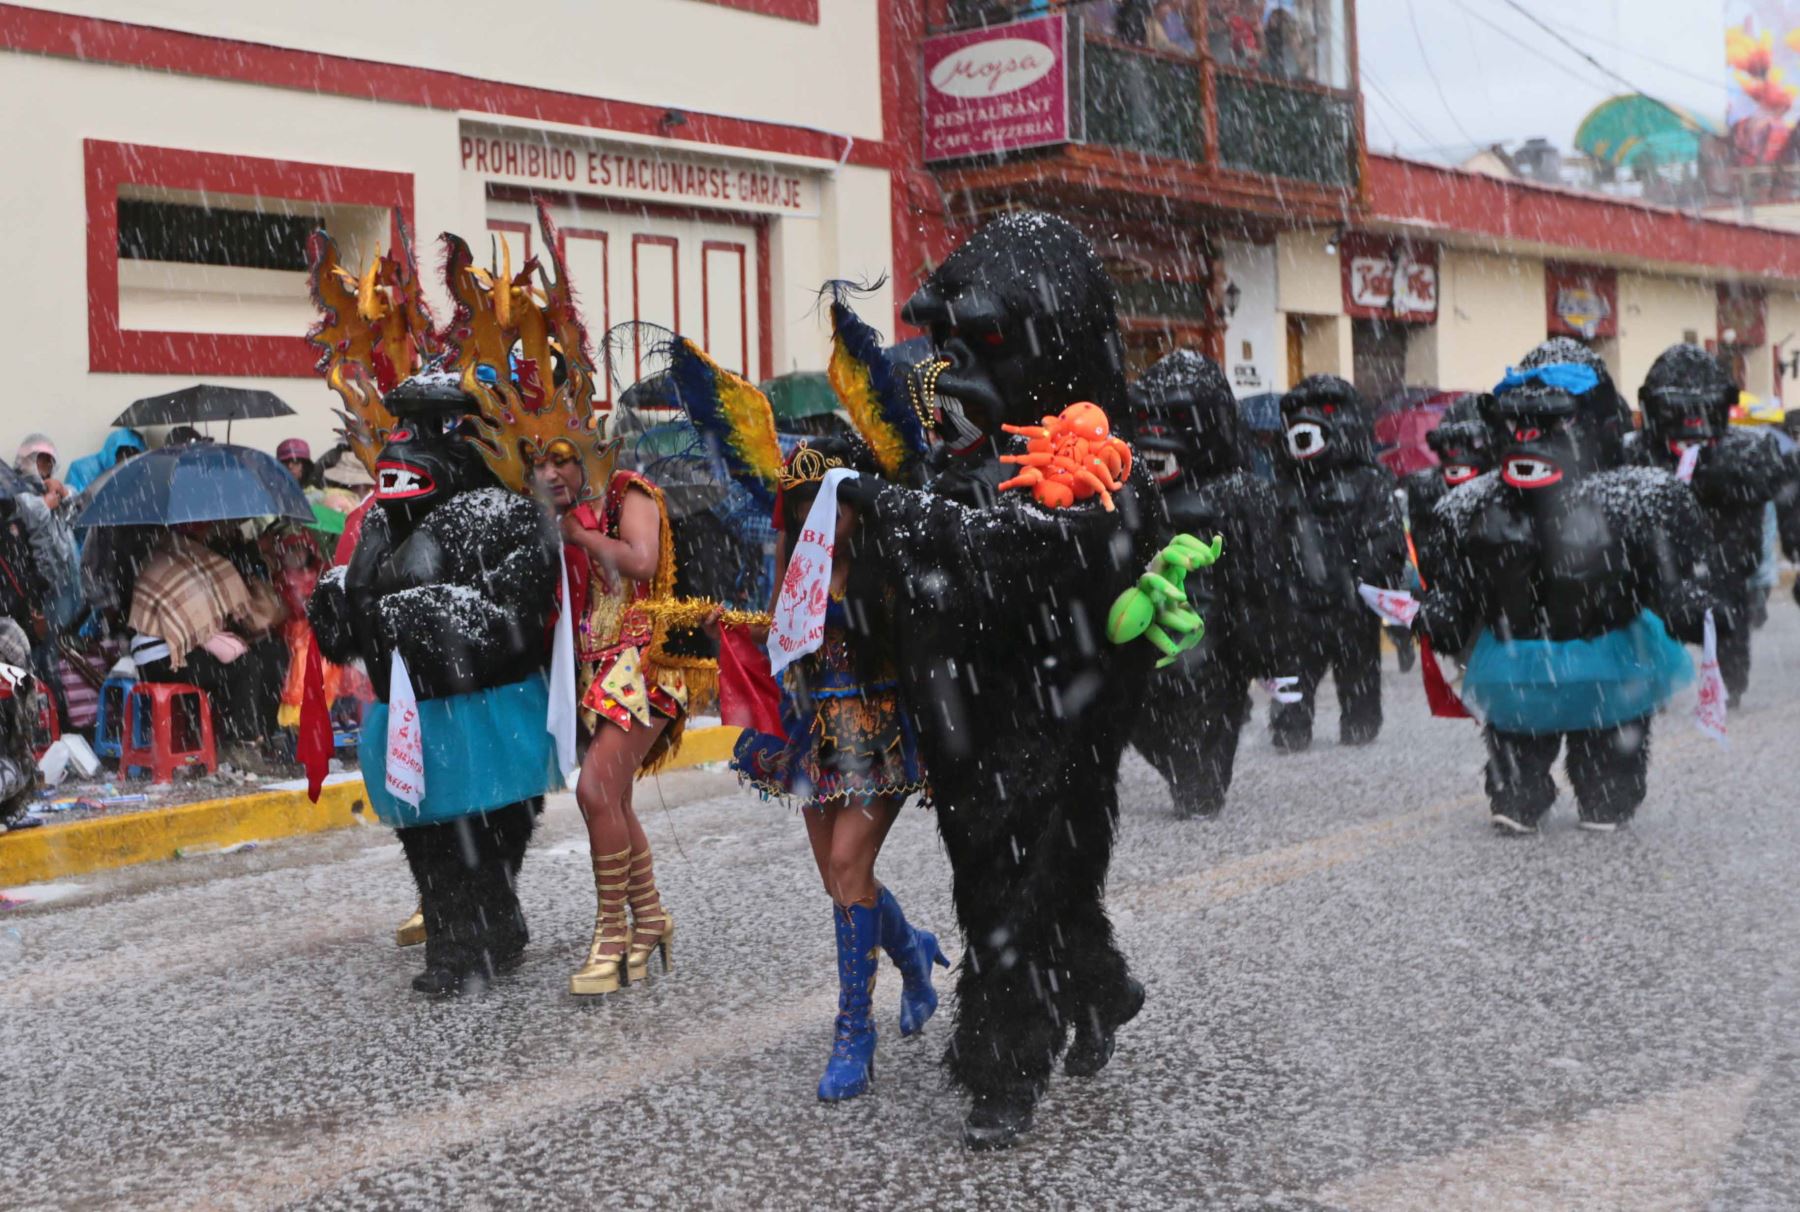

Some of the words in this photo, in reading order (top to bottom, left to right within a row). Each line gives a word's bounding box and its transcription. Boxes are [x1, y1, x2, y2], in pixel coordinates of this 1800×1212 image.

[933, 96, 1054, 128] RESTAURANT
[982, 120, 1054, 144] PIZZERIA
[461, 136, 576, 182] PROHIBIDO
